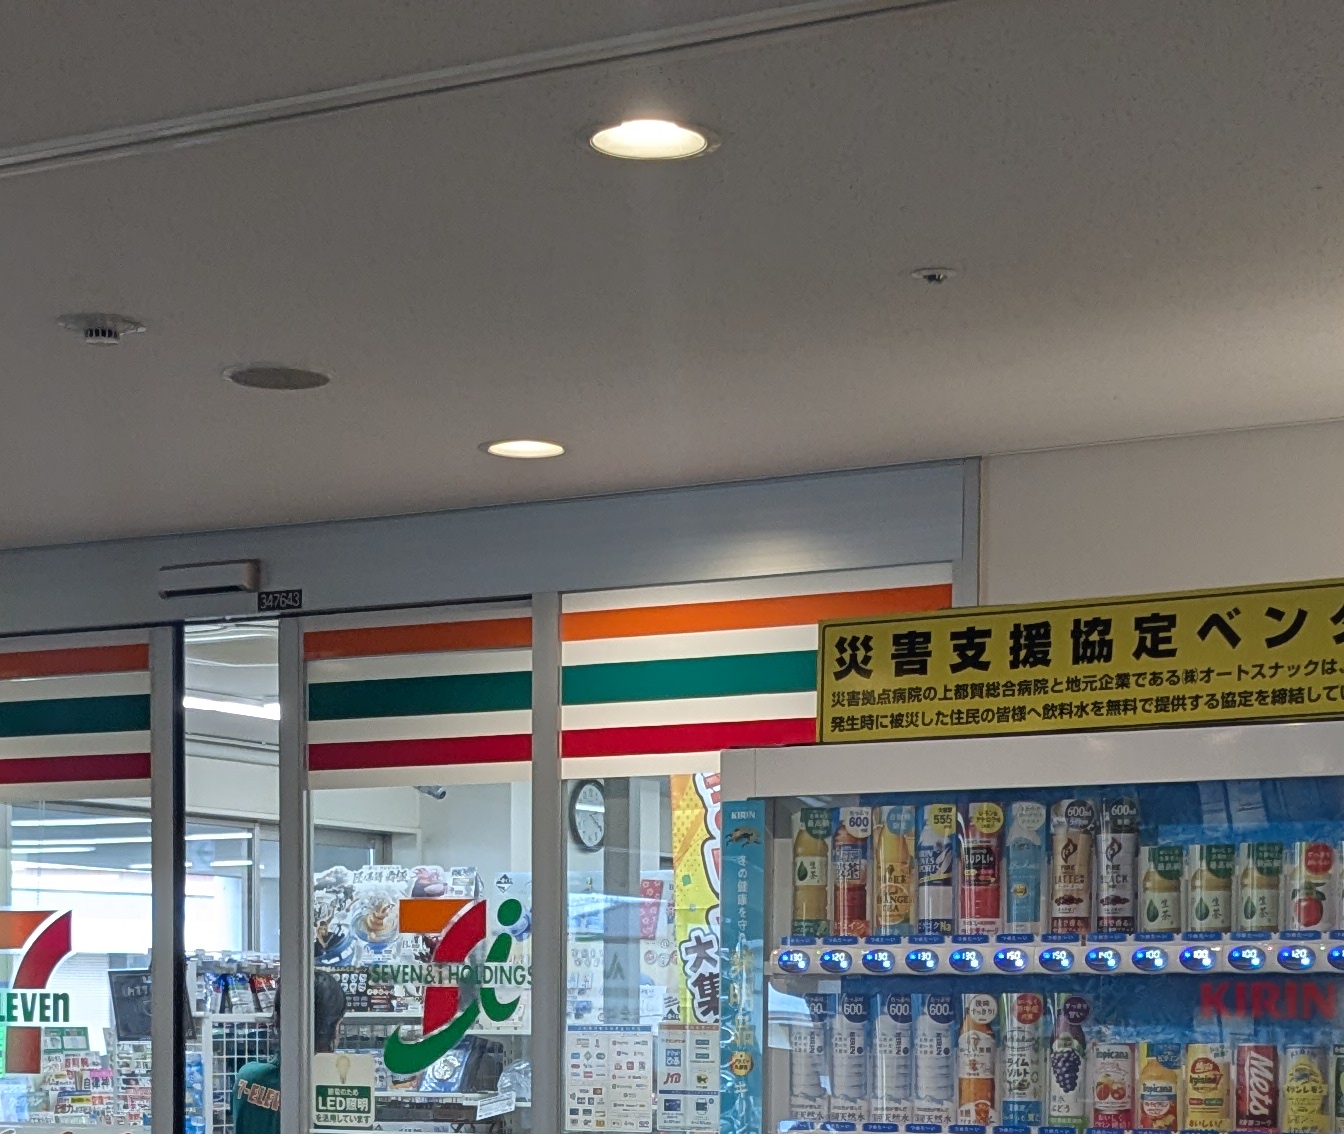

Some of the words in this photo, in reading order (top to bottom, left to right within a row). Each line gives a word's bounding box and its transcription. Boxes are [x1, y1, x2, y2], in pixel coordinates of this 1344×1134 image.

[730, 811, 757, 821] KIRIN
[1199, 979, 1338, 1020] KIRIN
[1250, 1050, 1273, 1115] Mets
[317, 1094, 370, 1113] LED照明
